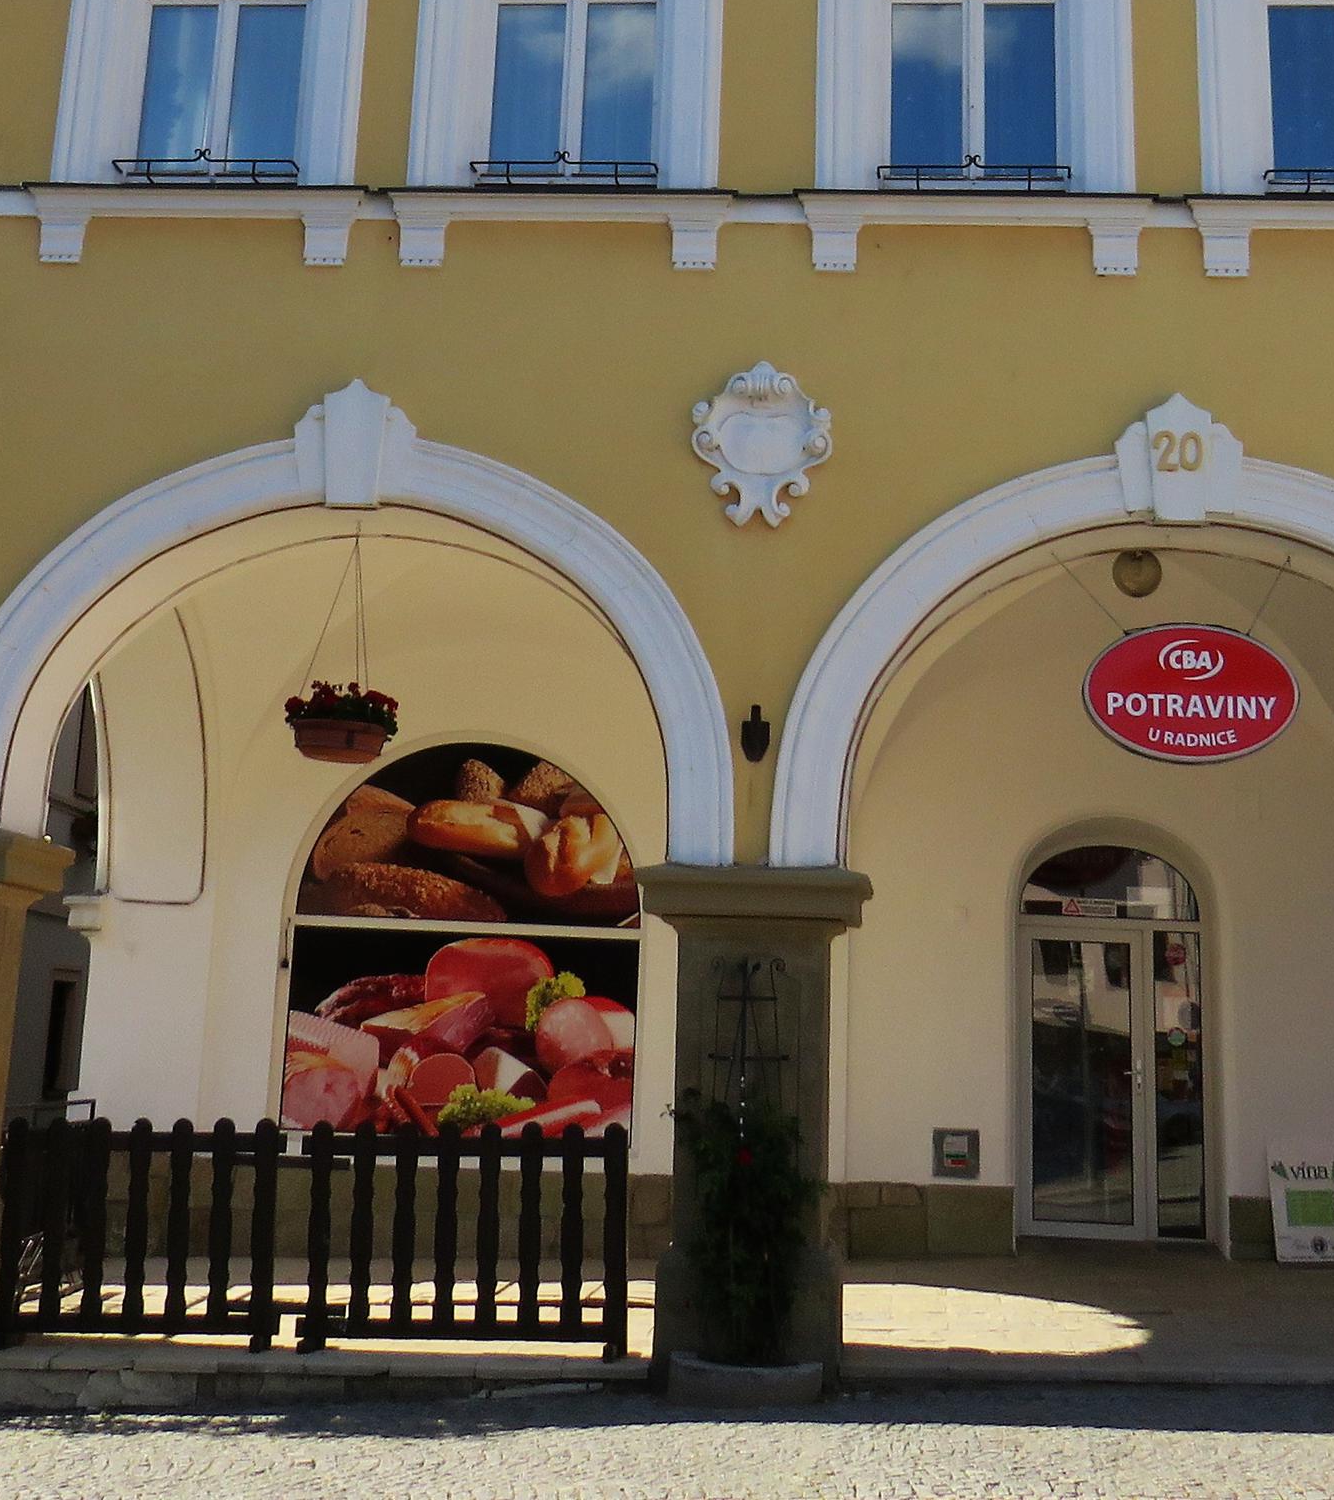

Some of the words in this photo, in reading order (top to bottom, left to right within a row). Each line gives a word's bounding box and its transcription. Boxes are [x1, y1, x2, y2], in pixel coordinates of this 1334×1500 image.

[1152, 430, 1204, 472] 20
[1168, 649, 1214, 671] CBA
[1106, 692, 1278, 721] POTRAVINY
[1148, 727, 1161, 743] U
[1163, 728, 1238, 747] RADNICE
